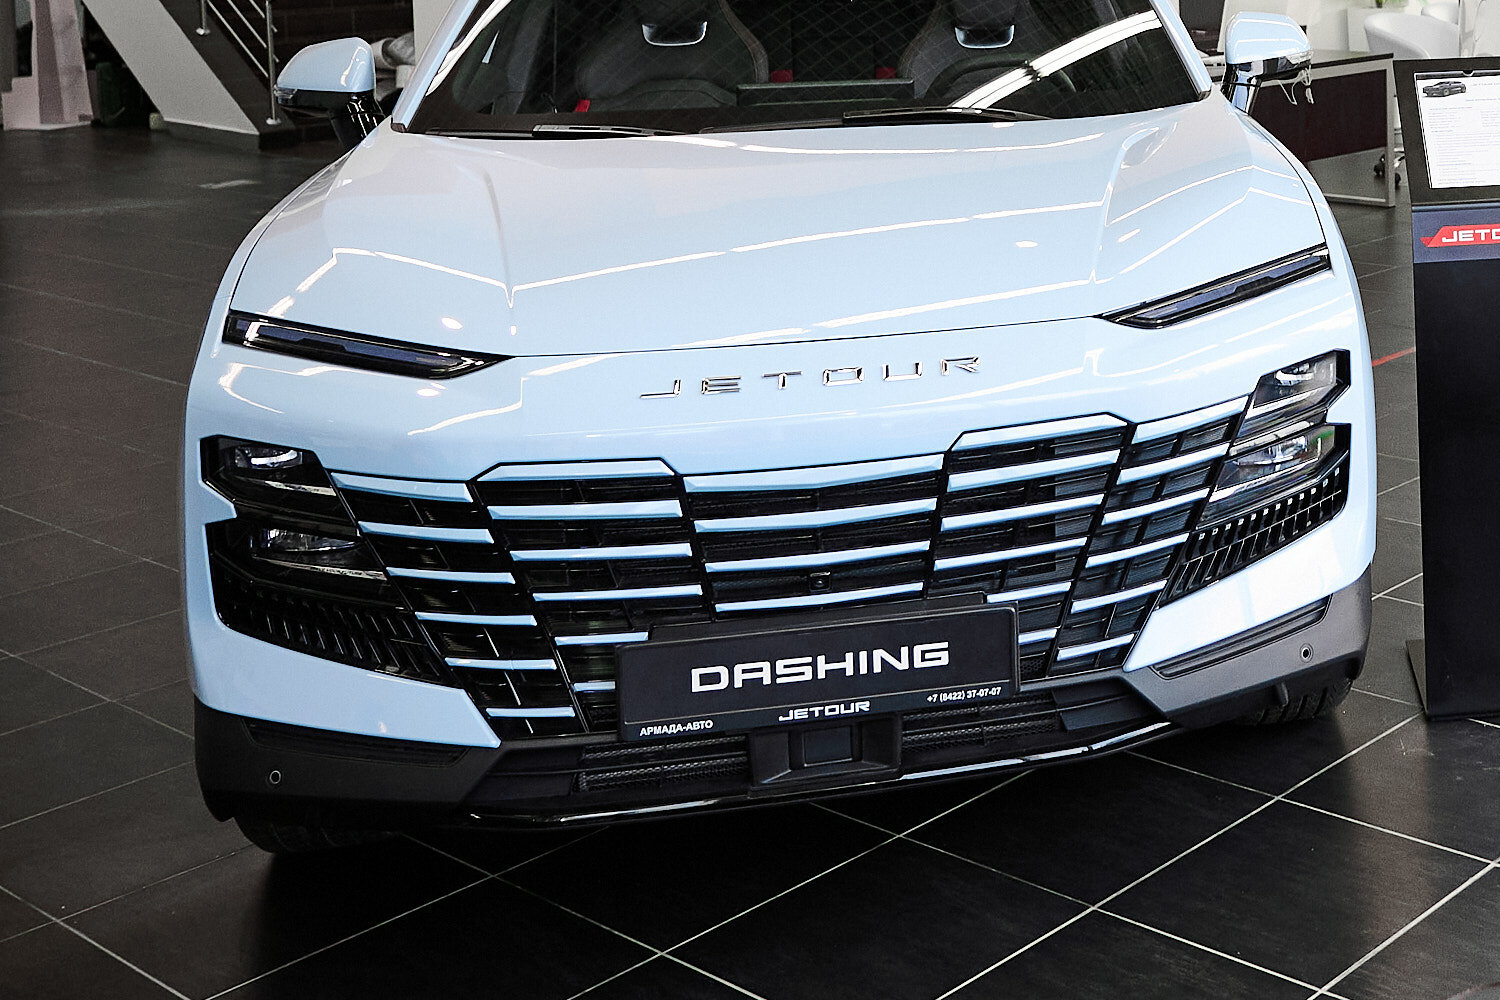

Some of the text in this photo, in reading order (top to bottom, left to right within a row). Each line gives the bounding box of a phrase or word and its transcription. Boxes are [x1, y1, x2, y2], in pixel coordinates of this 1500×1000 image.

[639, 355, 982, 399] JETOUR
[690, 641, 950, 694] DASHING
[926, 686, 1002, 703] +7 (8422) 37-07-07
[778, 700, 871, 721] JETOUR
[639, 718, 714, 737] АРМАДА-АВТО
